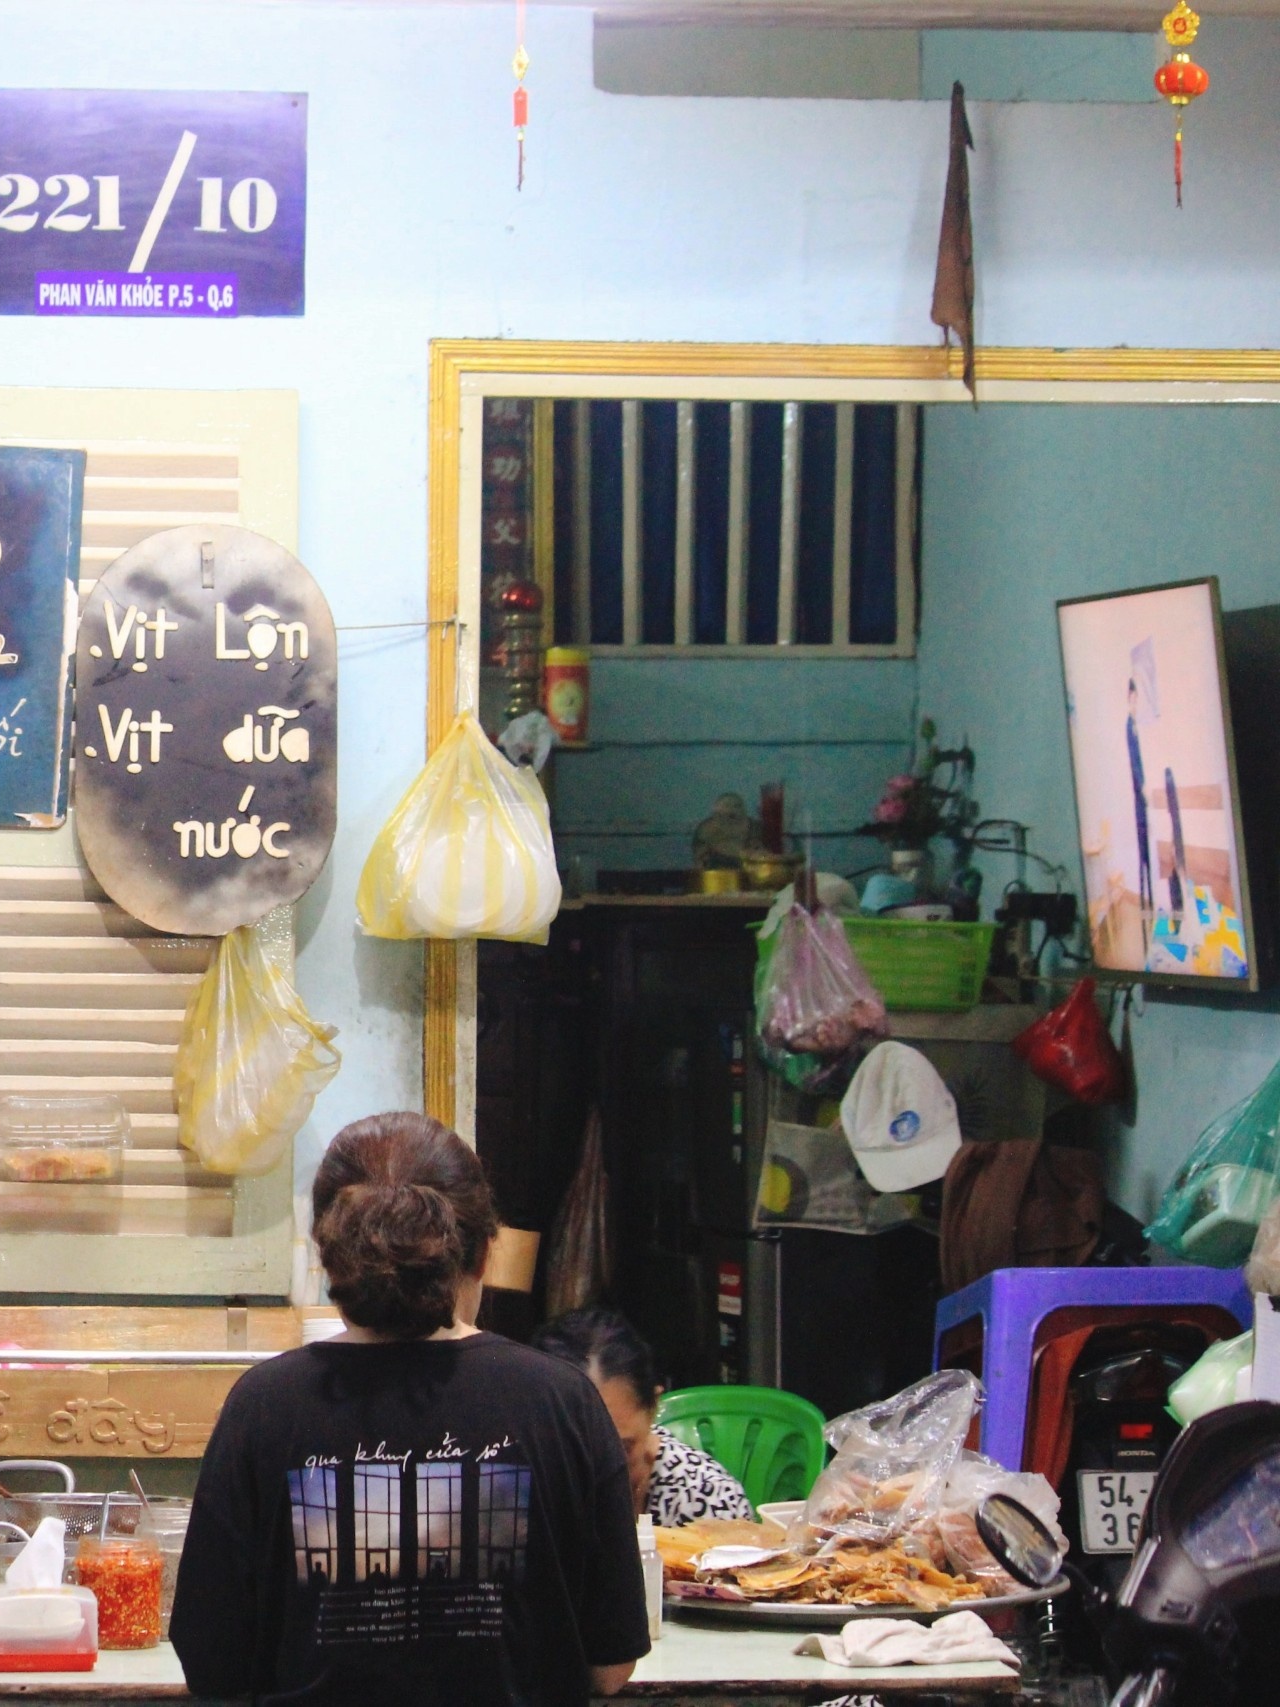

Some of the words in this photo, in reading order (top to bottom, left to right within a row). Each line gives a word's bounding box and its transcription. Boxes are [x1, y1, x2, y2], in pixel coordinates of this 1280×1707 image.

[39, 282, 82, 307] PHAN
[85, 279, 118, 308] VĂN
[121, 275, 164, 308] KHỎE
[168, 284, 194, 308] P.5
[207, 284, 234, 312] Q.6
[215, 602, 309, 671] Lộn
[173, 785, 291, 859] nước
[305, 1455, 343, 1479] qua
